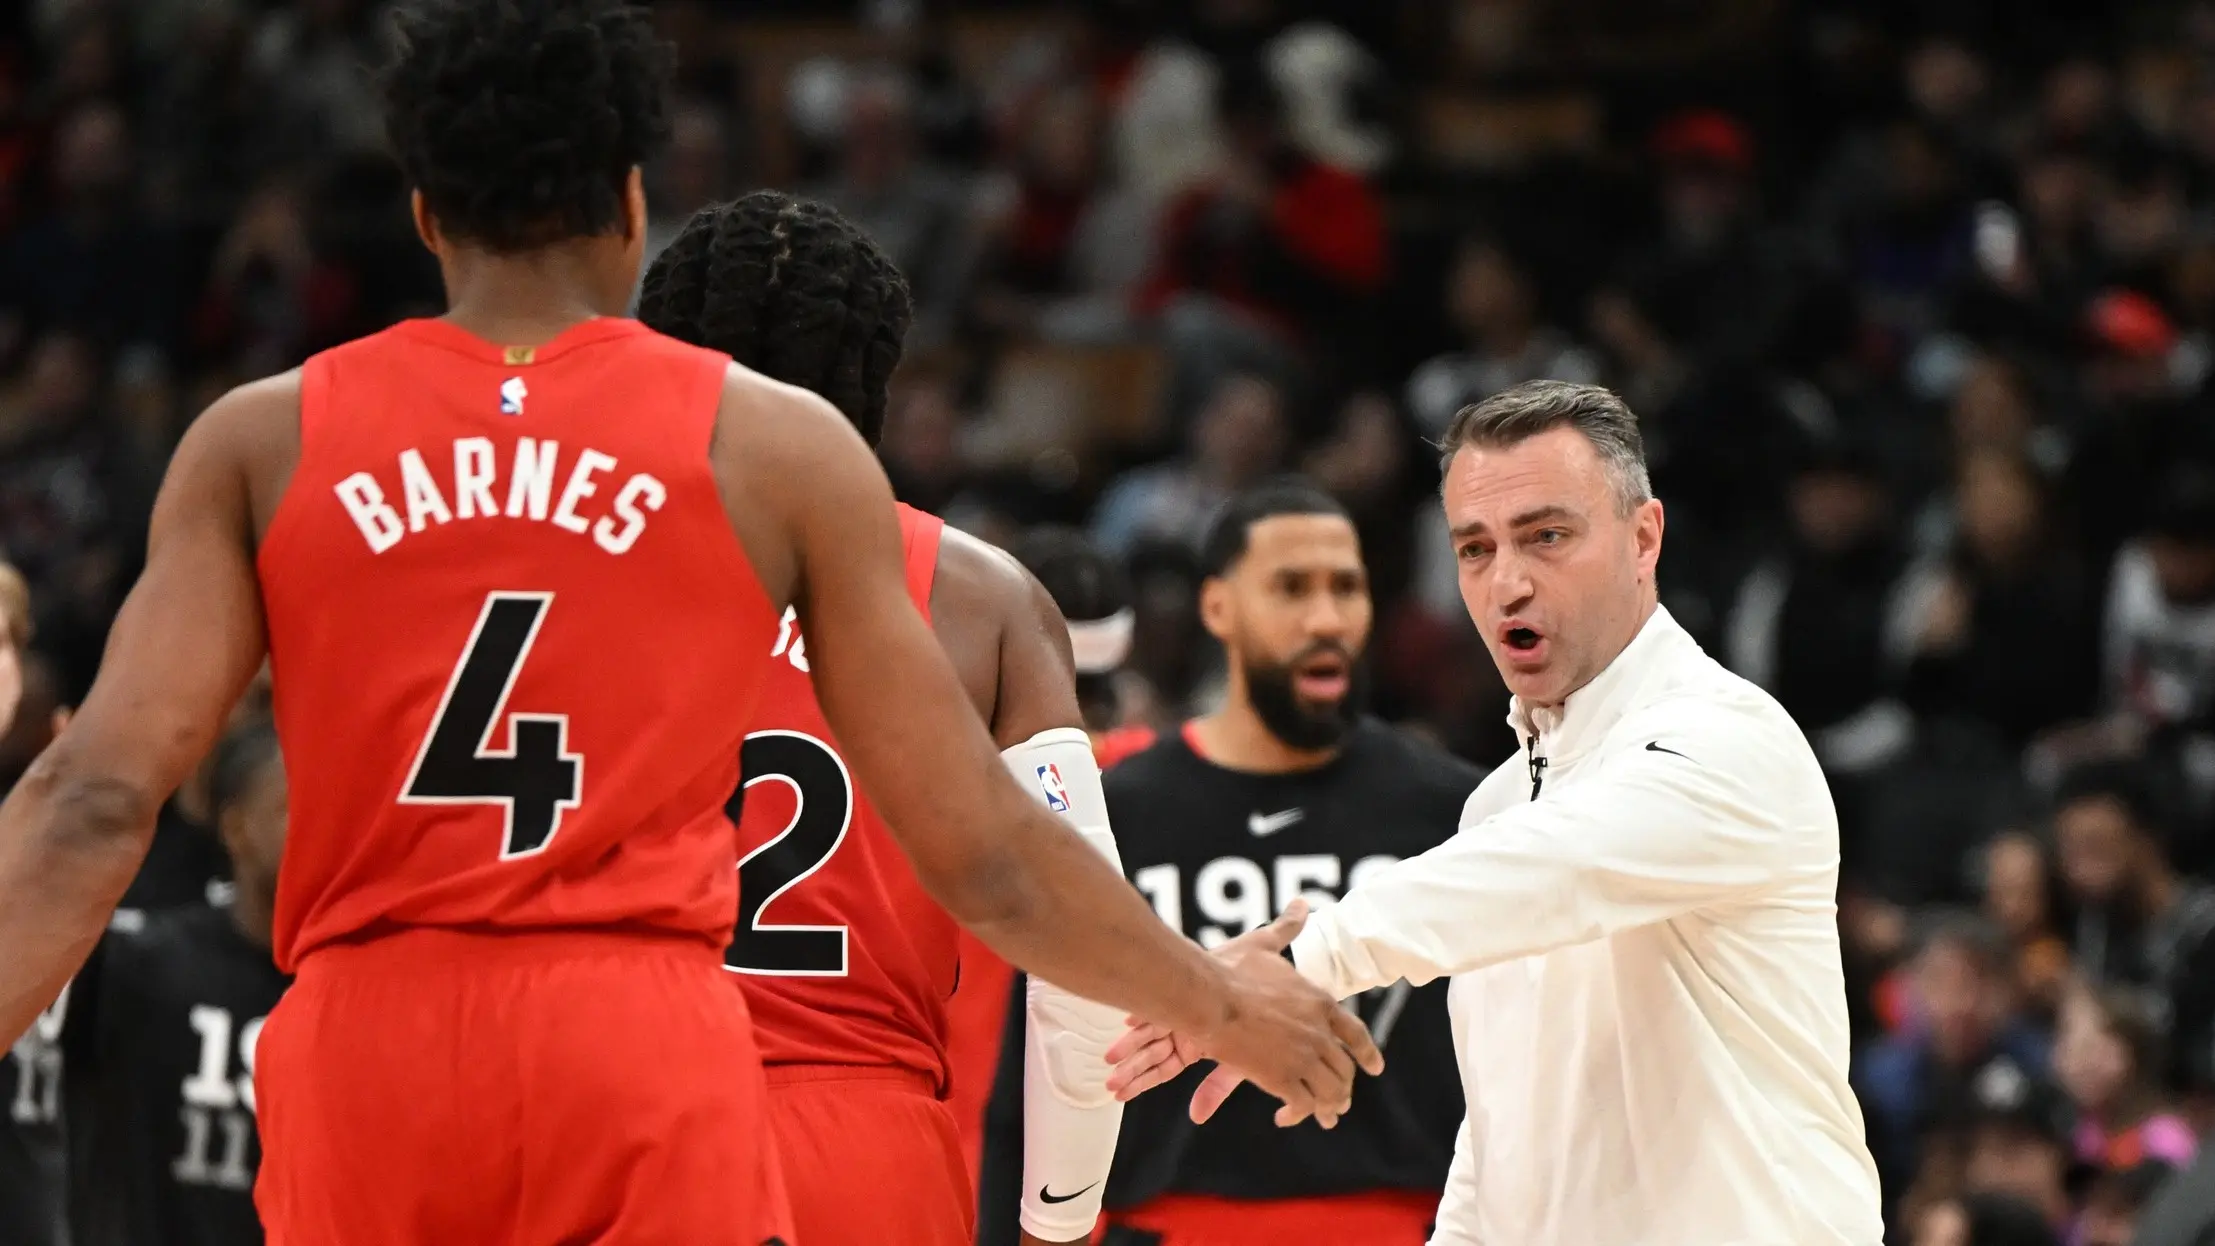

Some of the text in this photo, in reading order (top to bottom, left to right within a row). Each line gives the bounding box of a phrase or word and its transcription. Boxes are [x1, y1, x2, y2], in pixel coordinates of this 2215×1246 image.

[333, 436, 668, 556] BARNES
[396, 590, 585, 862] 4
[721, 729, 854, 977] 2
[1135, 853, 1402, 950] 195
